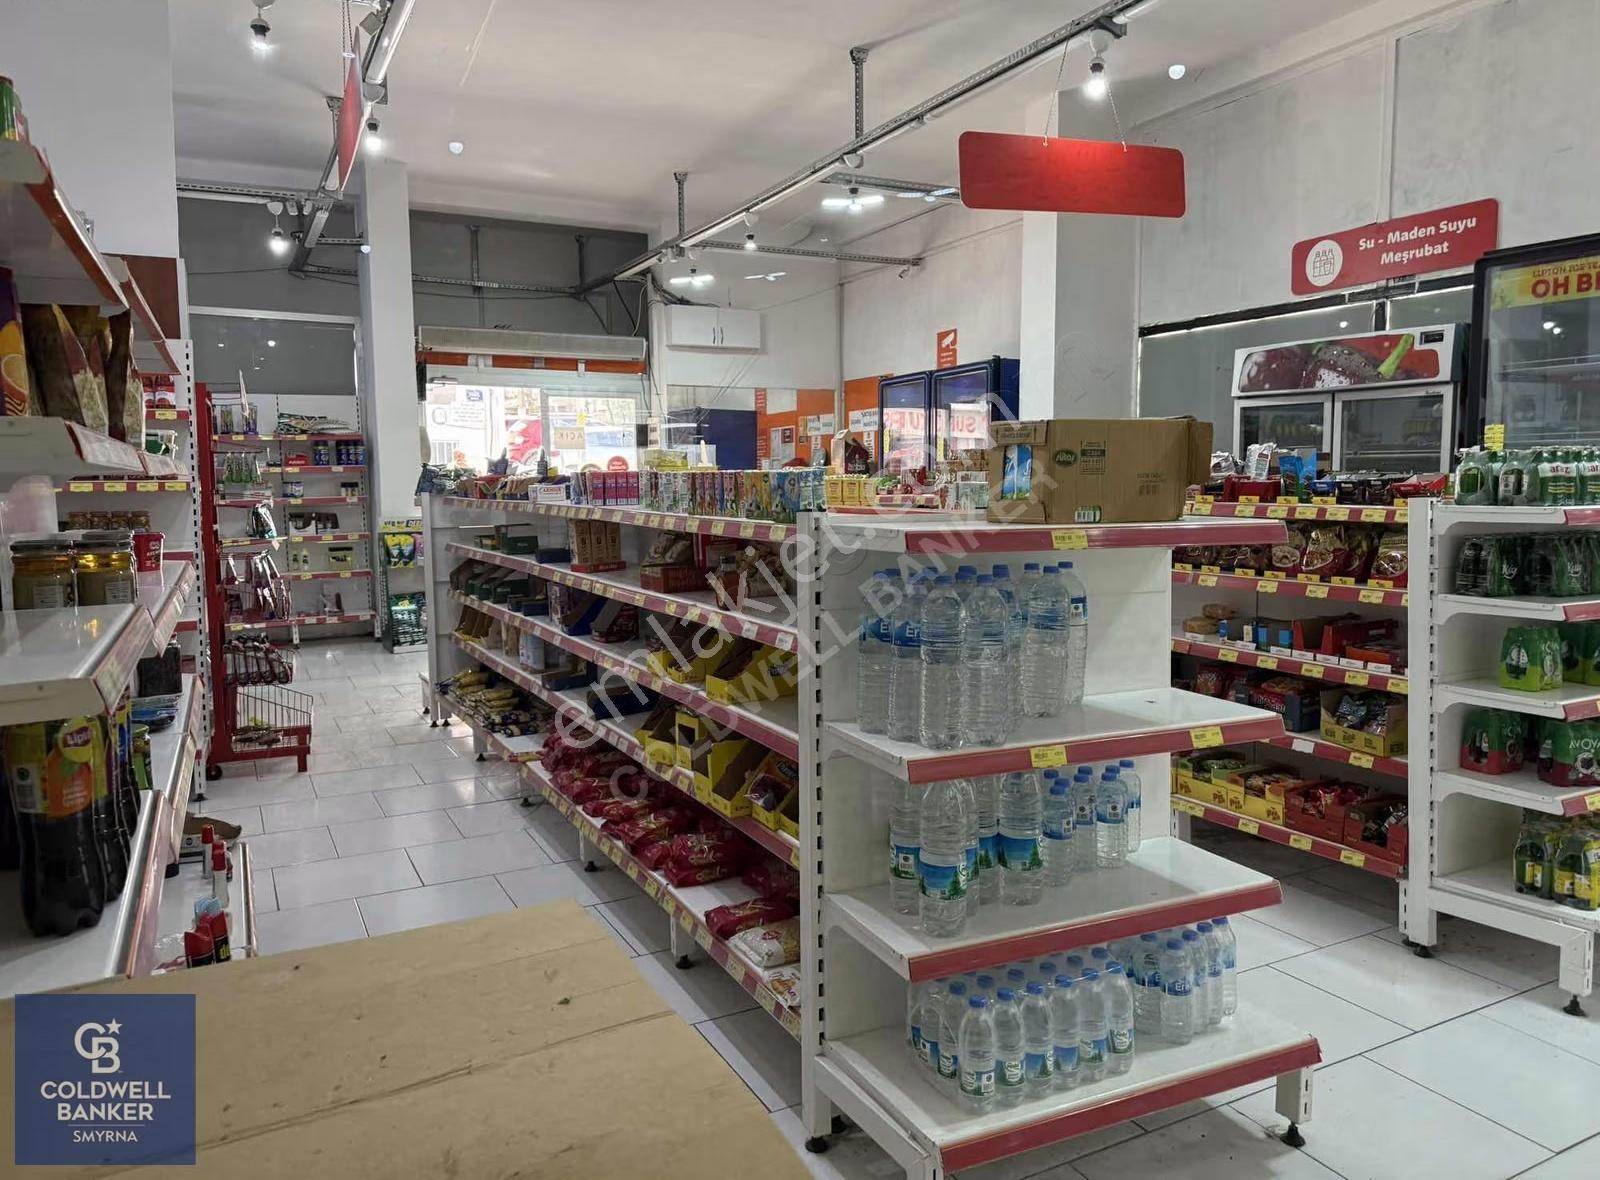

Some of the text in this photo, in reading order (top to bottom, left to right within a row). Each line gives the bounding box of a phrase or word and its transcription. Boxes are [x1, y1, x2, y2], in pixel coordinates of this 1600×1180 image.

[1358, 237, 1375, 251] Su
[1387, 224, 1436, 245] Maden
[1439, 216, 1477, 237] Suyu
[1380, 241, 1449, 265] Meşrubat
[1531, 274, 1570, 298] OH
